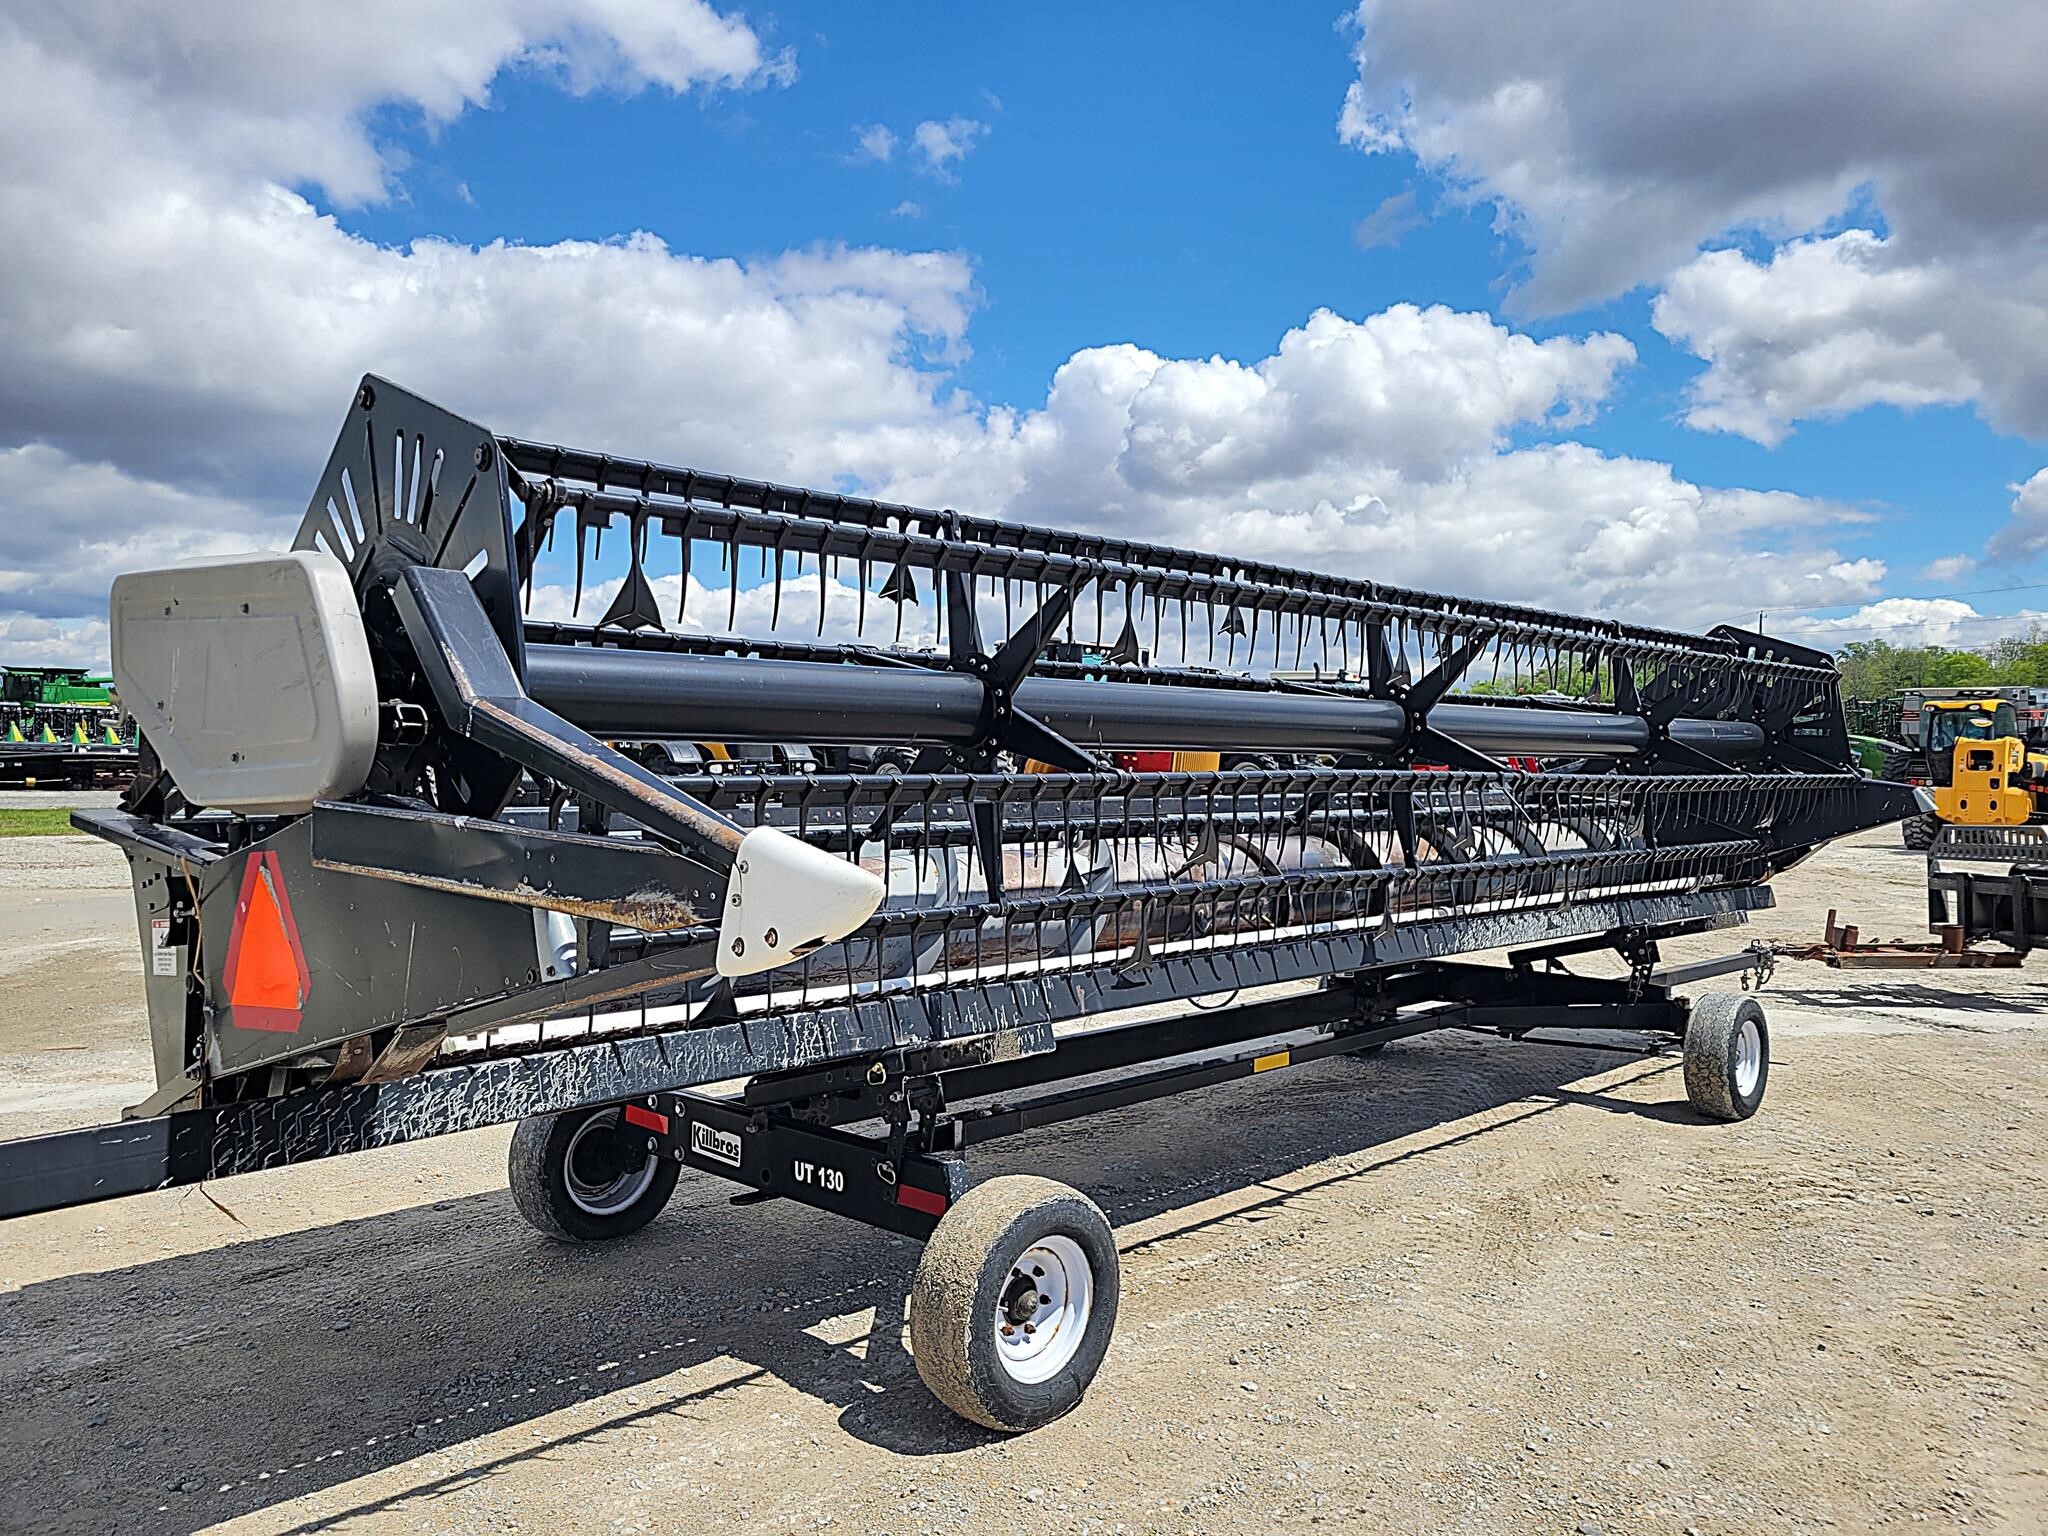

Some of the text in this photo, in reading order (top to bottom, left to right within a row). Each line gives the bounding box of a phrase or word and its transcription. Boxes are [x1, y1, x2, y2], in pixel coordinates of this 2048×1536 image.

[692, 1124, 740, 1157] Killbros
[794, 1160, 844, 1192] UT 130
